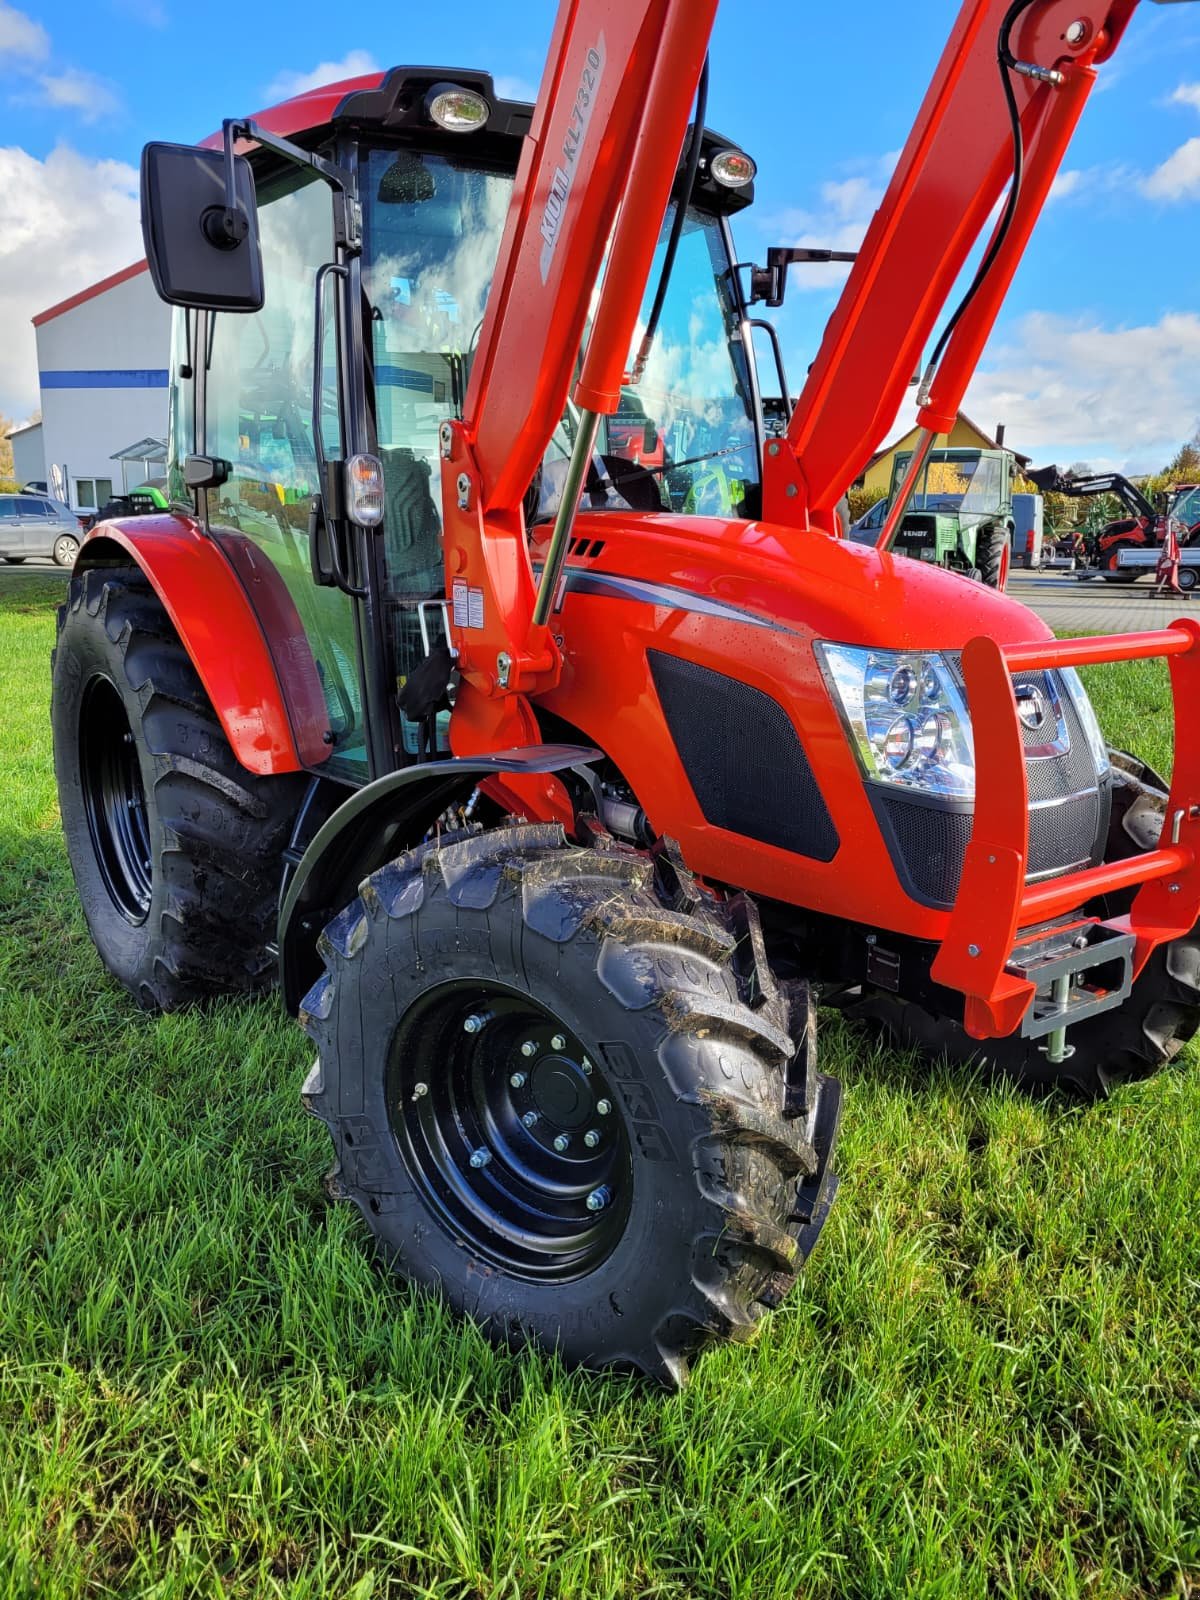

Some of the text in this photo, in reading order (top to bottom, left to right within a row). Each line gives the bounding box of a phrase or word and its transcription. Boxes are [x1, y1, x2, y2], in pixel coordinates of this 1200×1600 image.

[540, 48, 601, 247] KIOTI KL7320
[598, 1041, 679, 1161] BKT
